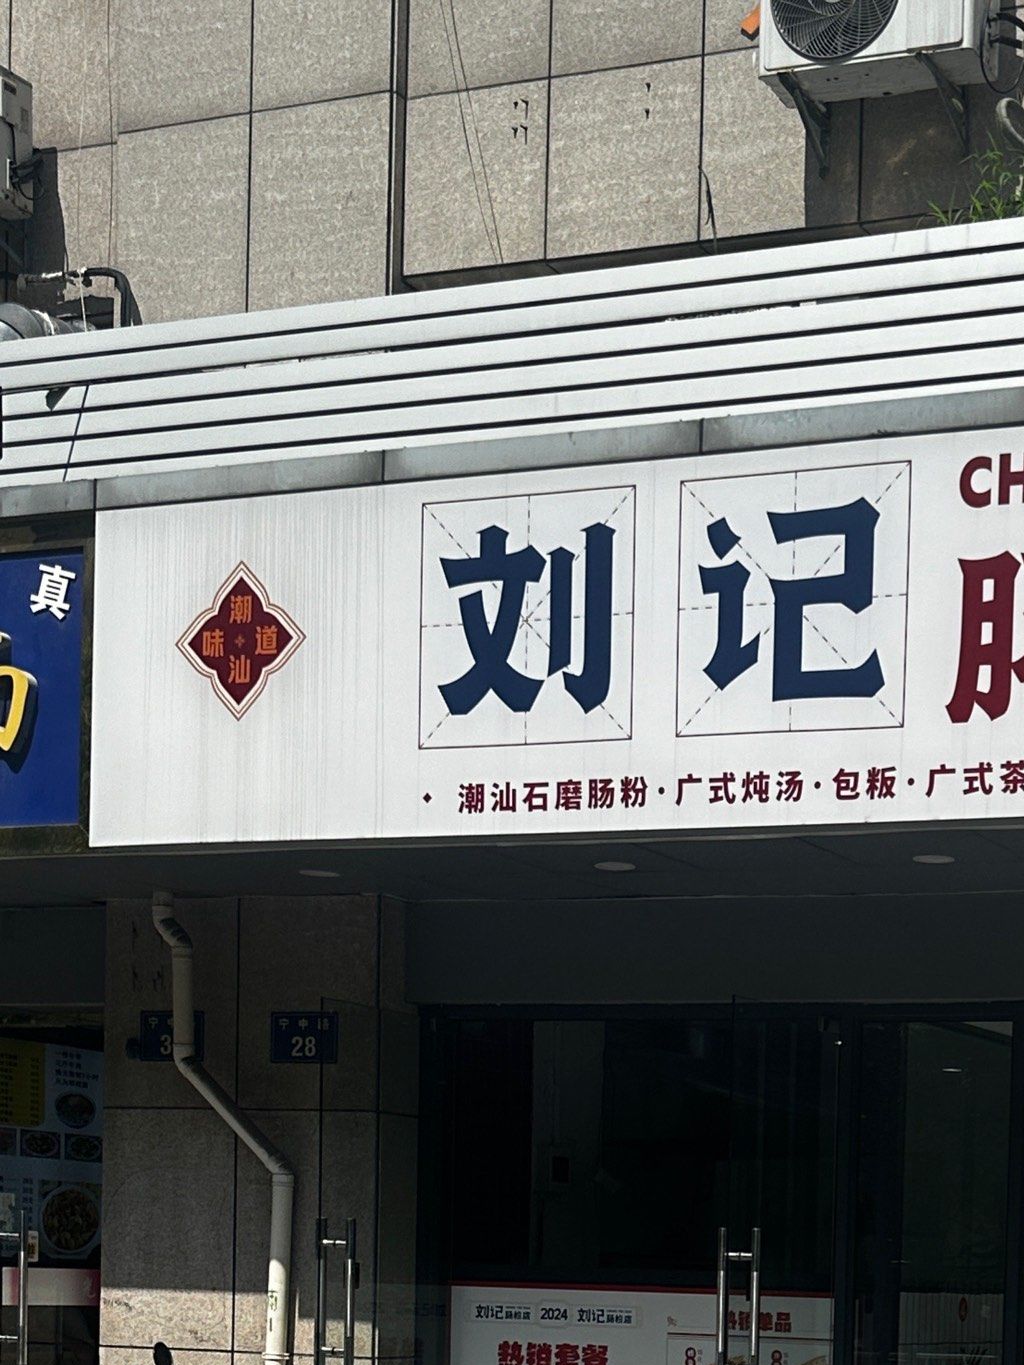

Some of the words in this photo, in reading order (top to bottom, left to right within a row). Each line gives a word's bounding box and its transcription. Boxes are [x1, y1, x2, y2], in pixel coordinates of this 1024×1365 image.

[30, 564, 76, 620] 真
[438, 497, 885, 716] 刘记
[290, 1035, 317, 1057] 28
[540, 1307, 568, 1320] 2024
